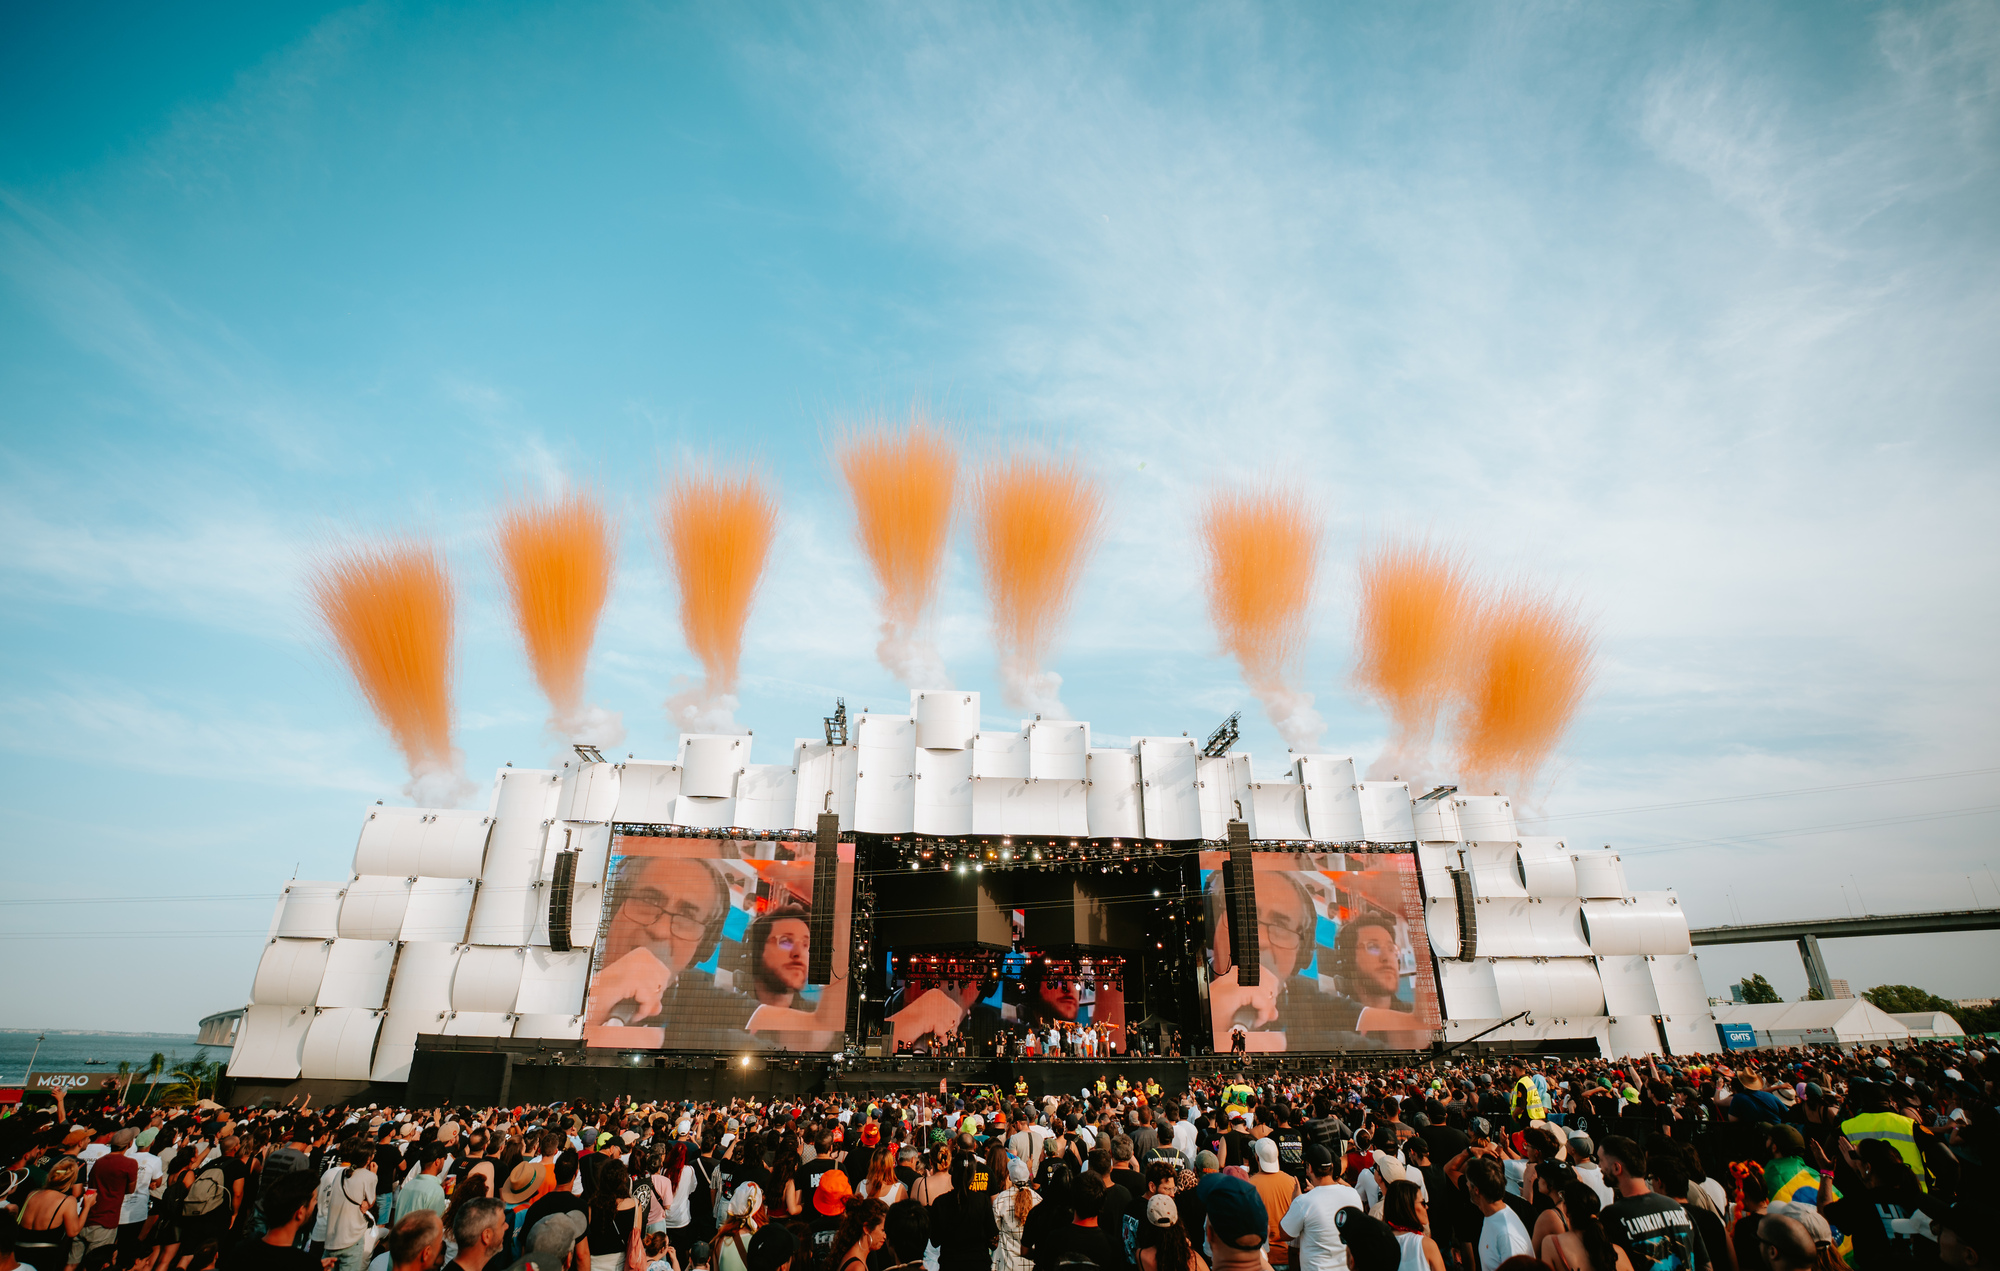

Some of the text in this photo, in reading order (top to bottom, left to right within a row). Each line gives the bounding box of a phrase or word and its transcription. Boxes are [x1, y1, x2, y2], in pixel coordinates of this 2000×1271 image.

[1730, 1033, 1751, 1041] GMTS
[1625, 1209, 1690, 1235] LINKIN PARK
